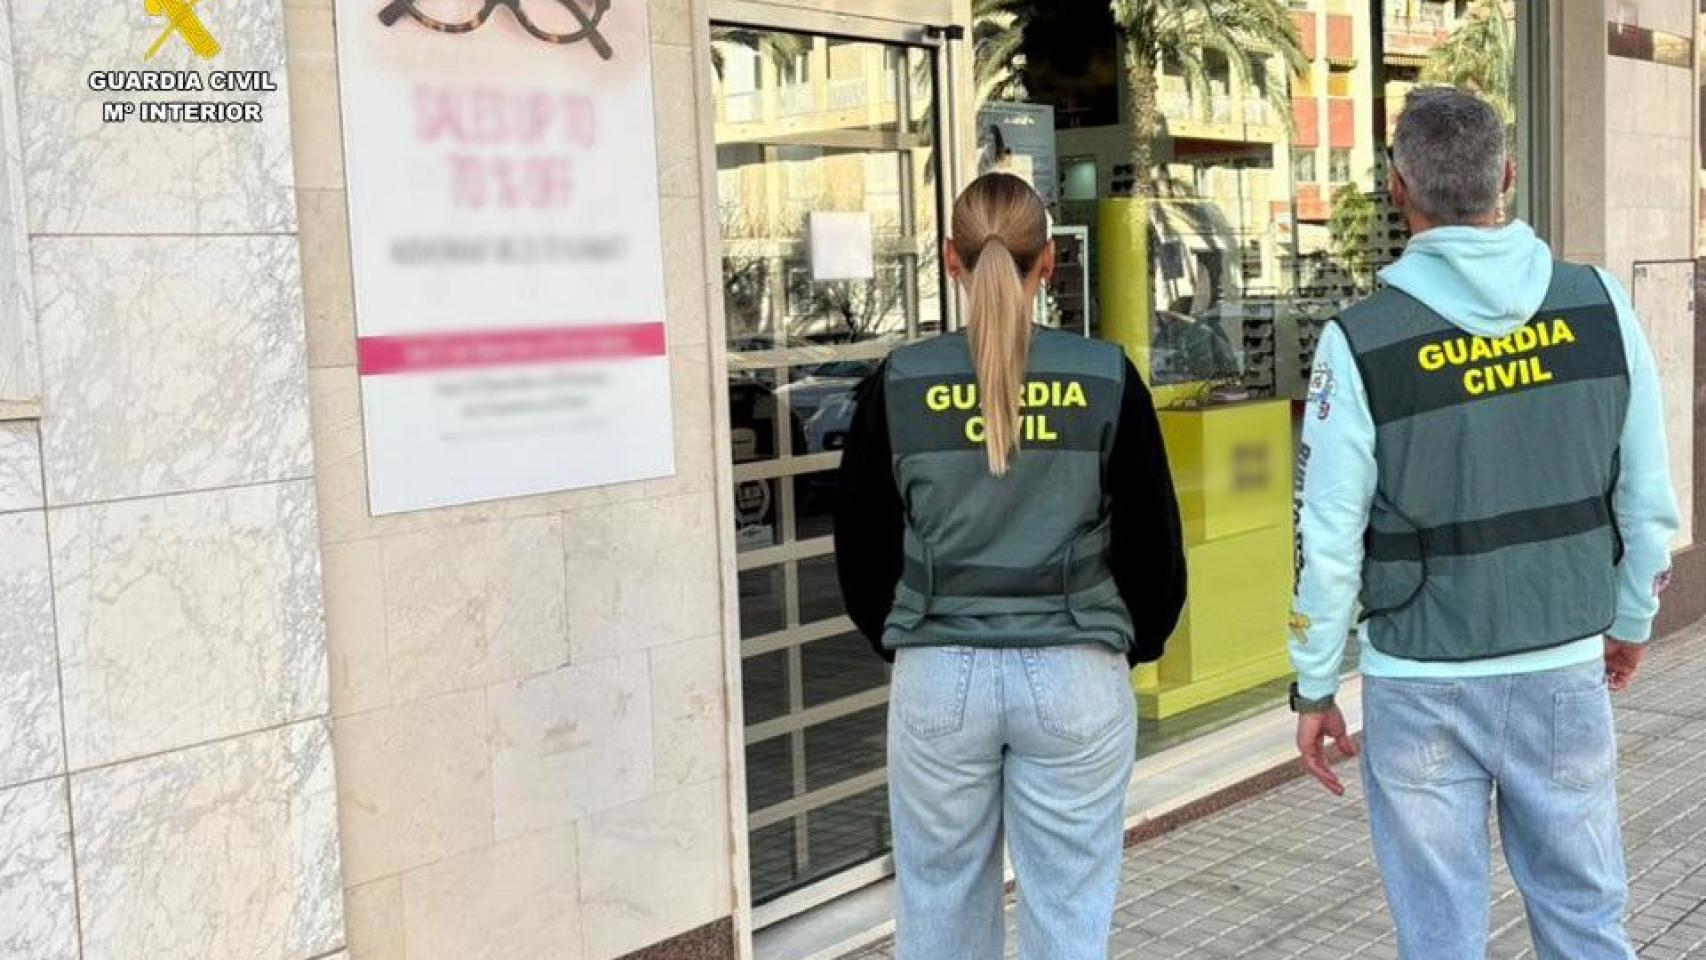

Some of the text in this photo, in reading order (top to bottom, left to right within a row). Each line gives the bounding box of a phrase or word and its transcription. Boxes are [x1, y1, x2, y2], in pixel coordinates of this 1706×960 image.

[1418, 319, 1576, 371] GUARDIA
[1463, 356, 1553, 396] CIVIL
[925, 381, 1087, 411] GUDIA
[964, 415, 1058, 442] CIL
